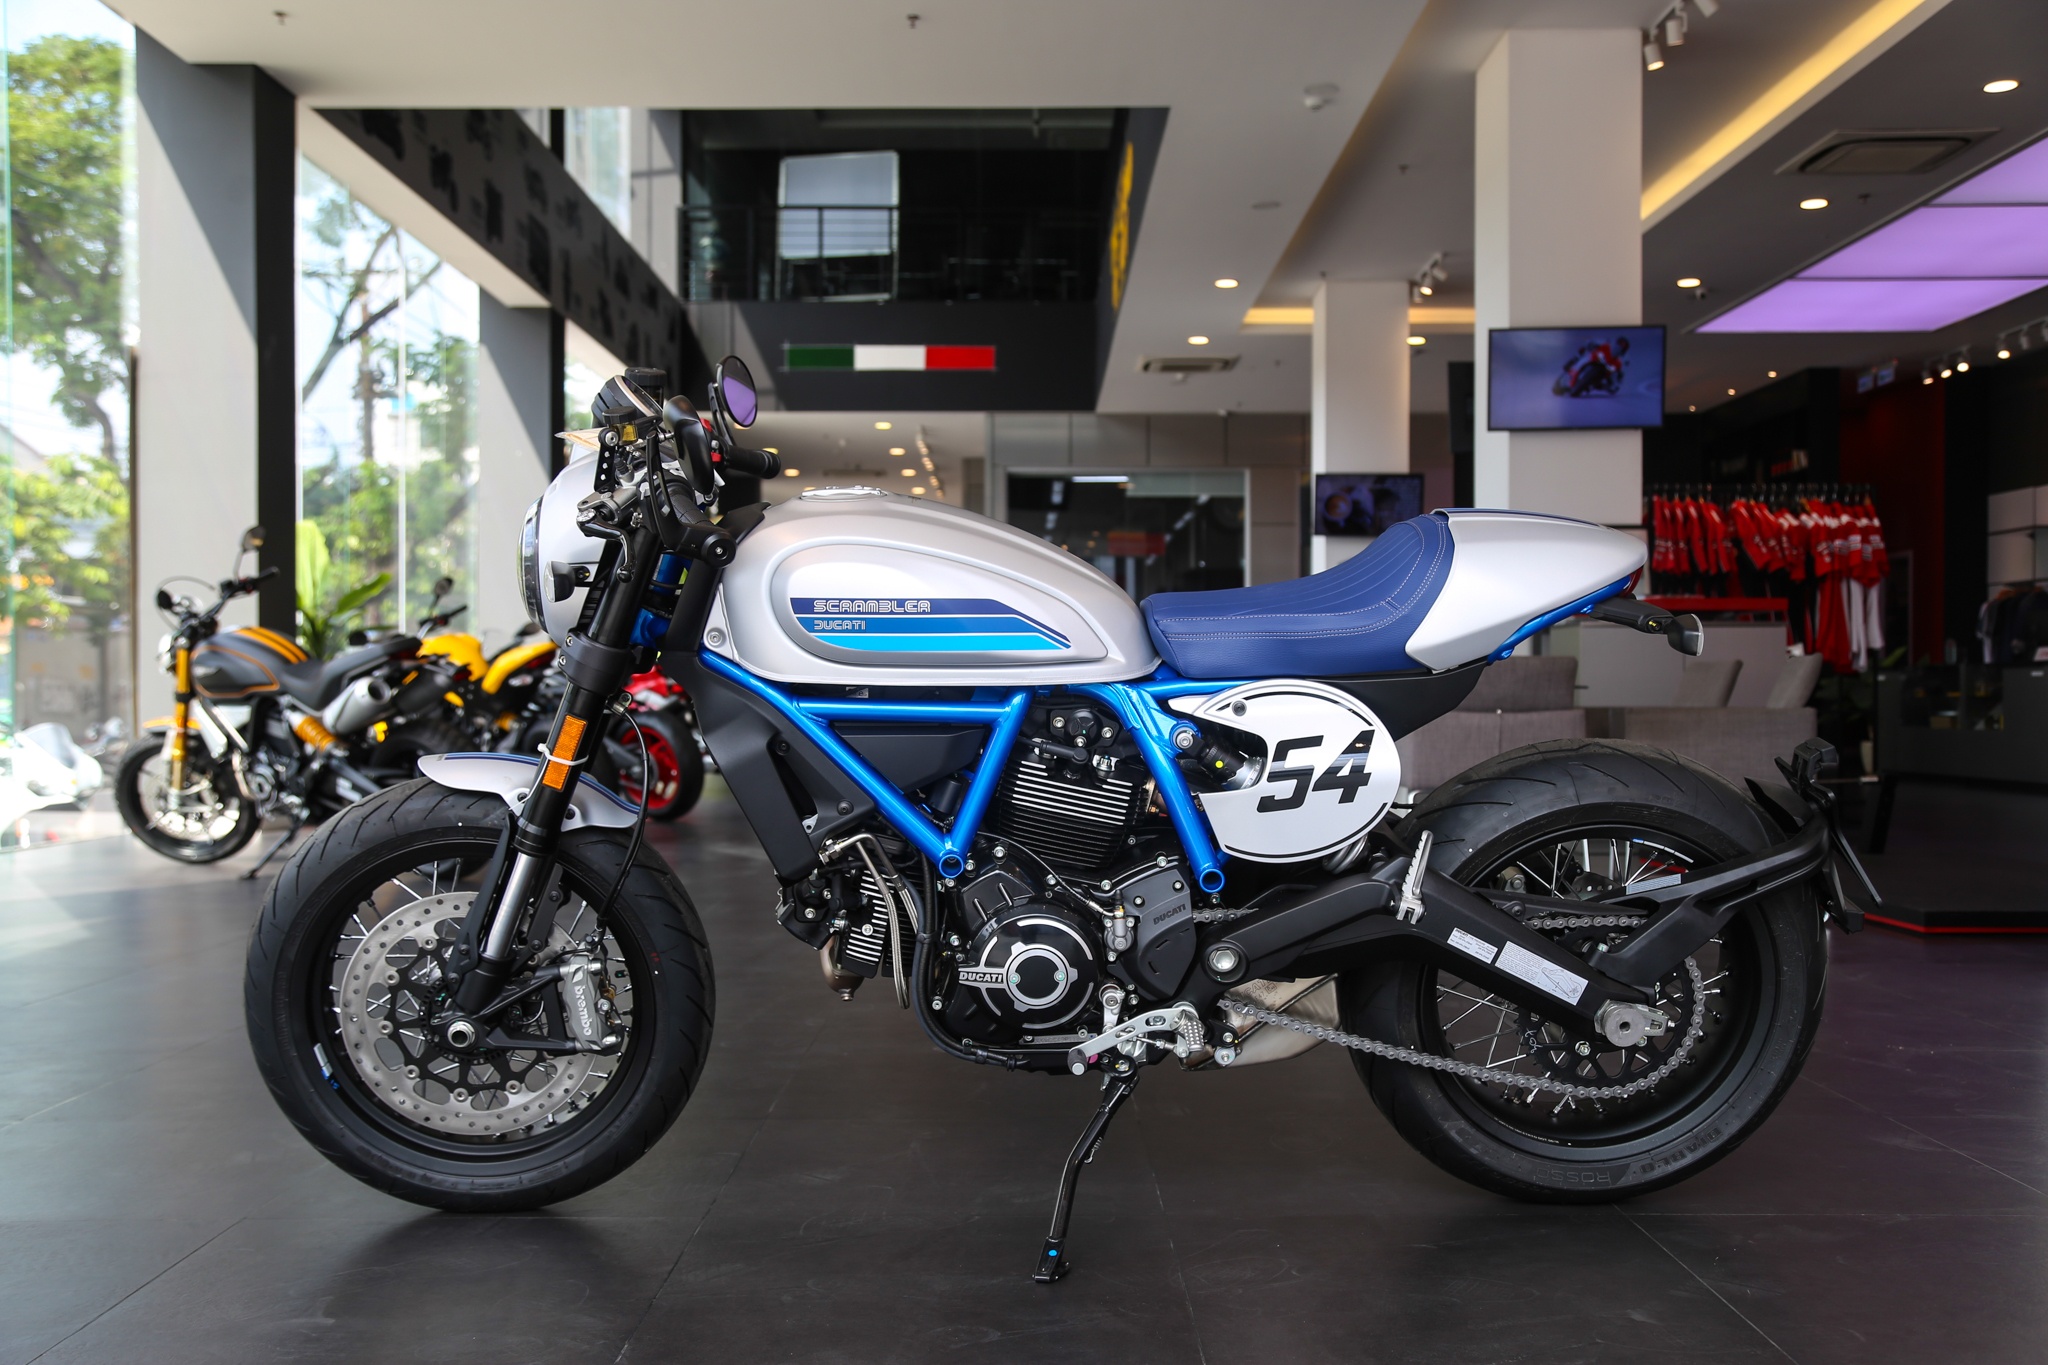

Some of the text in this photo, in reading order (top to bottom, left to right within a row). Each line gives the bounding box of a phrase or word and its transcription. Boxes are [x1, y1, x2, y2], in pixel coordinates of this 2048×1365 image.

[813, 600, 931, 613] SCRAMBLER
[814, 620, 866, 630] DUCATI
[1256, 729, 1376, 813] 54
[1153, 903, 1187, 925] DUCATI
[959, 971, 1003, 983] DUCATI
[574, 985, 592, 1036] brembo
[1638, 1126, 1723, 1175] DIABLO
